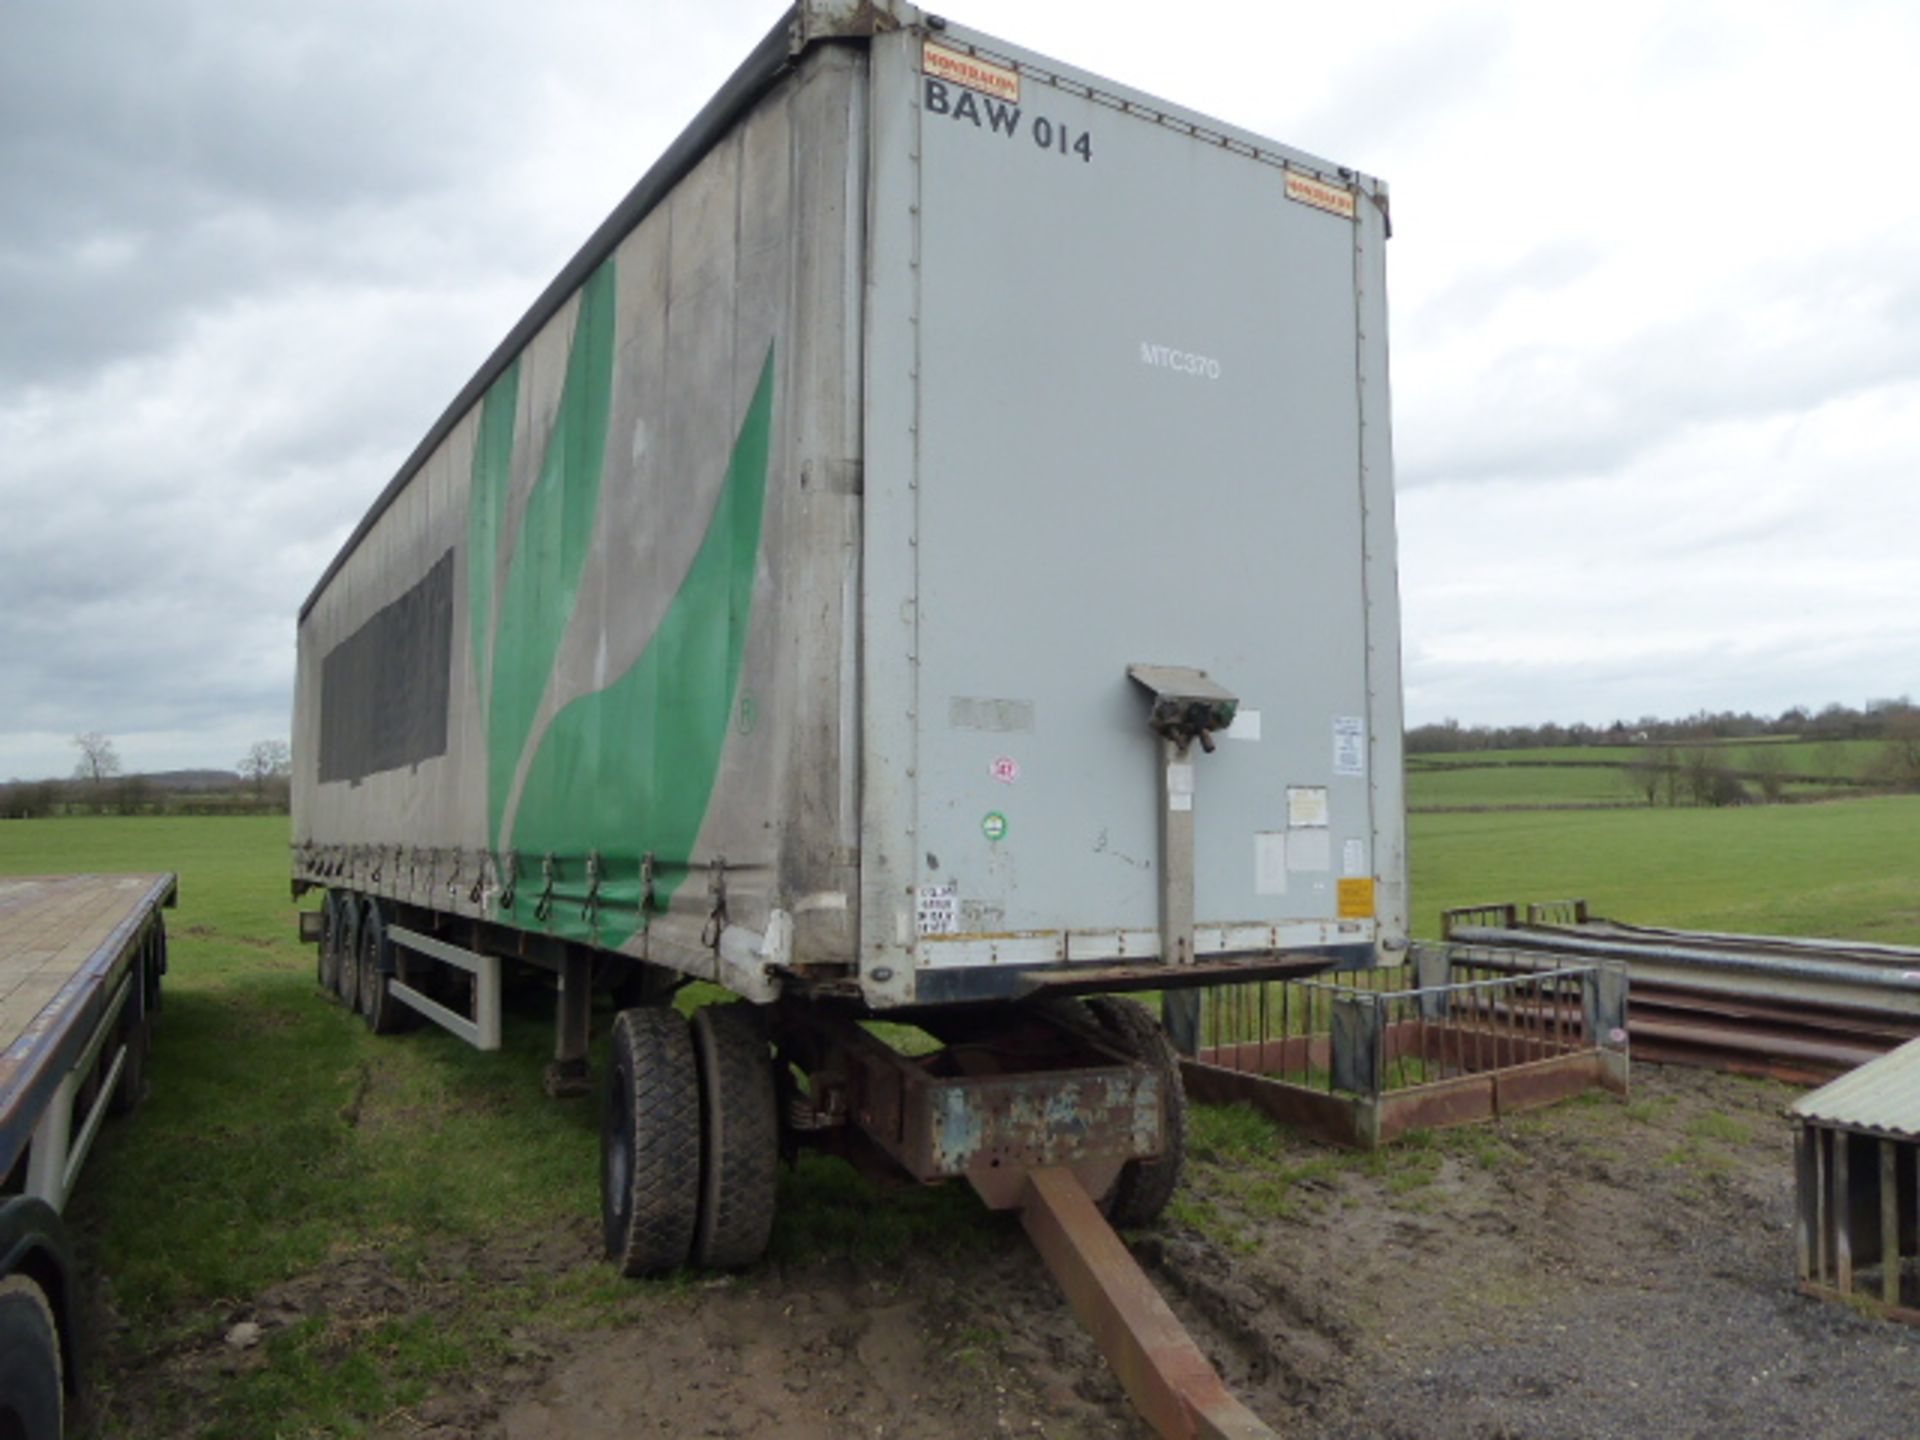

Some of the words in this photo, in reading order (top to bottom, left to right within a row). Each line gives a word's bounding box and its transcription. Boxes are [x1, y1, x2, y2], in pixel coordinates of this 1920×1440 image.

[925, 78, 1021, 138] BAW
[1032, 115, 1092, 163] 014
[1140, 341, 1221, 379] MTC370
